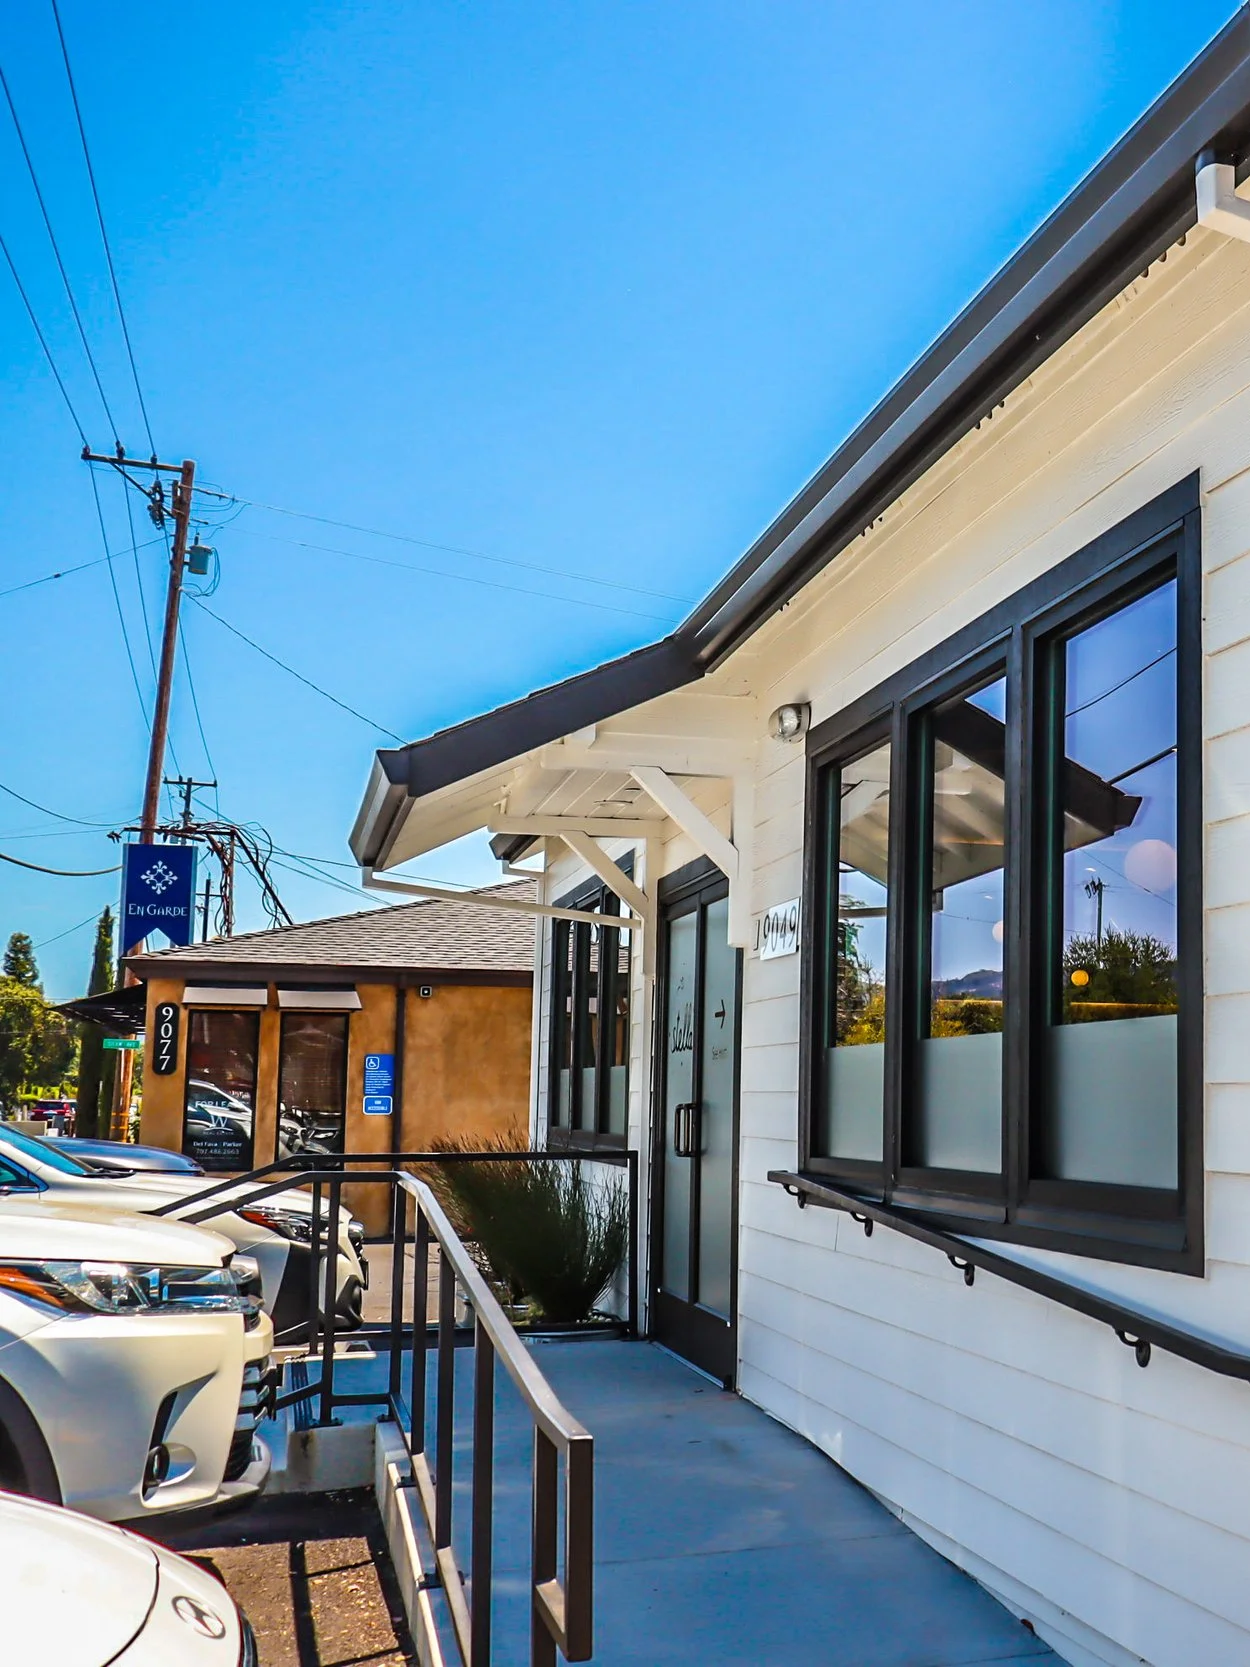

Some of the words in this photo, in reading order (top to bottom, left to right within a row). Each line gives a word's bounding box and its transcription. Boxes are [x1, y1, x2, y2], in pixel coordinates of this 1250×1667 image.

[763, 905, 797, 955] 9049
[159, 1006, 174, 1071] 9077
[671, 1002, 693, 1054] stella
